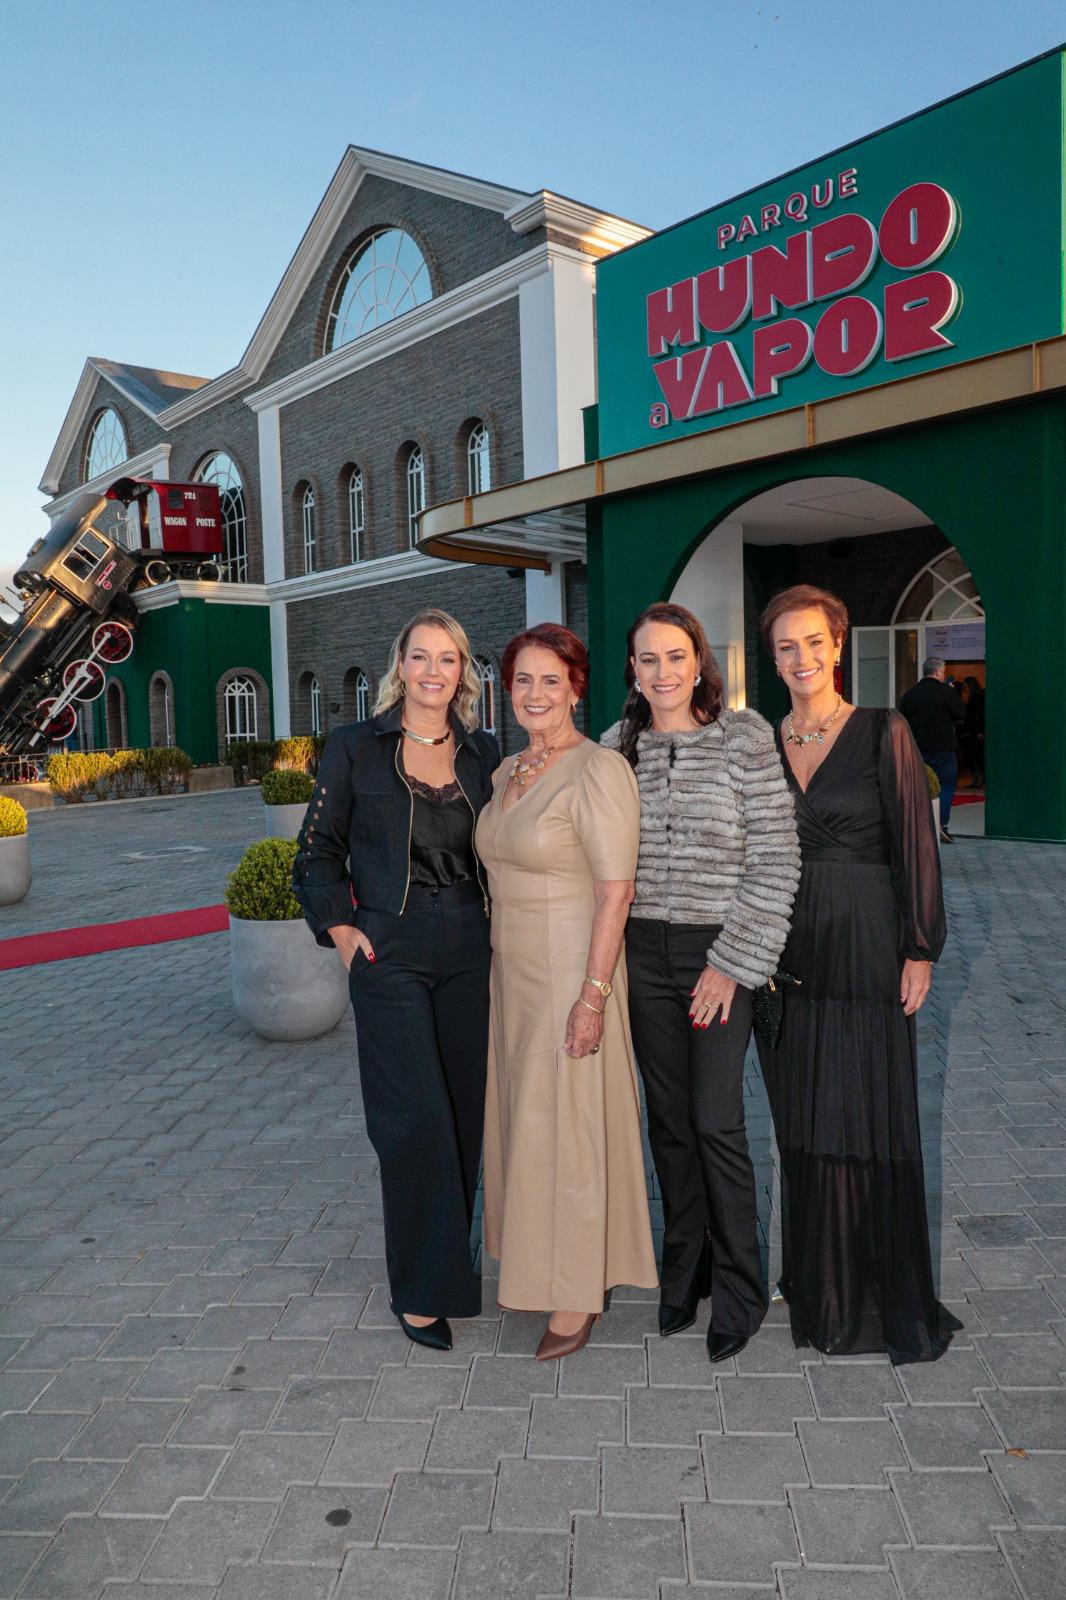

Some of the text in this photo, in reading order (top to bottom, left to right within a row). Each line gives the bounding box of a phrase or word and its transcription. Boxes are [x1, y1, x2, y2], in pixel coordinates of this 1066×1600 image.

[717, 168, 858, 249] PARQUE
[646, 182, 956, 357] MUNDO
[650, 271, 957, 428] a VAPOR
[164, 516, 216, 528] WAGON POSTE
